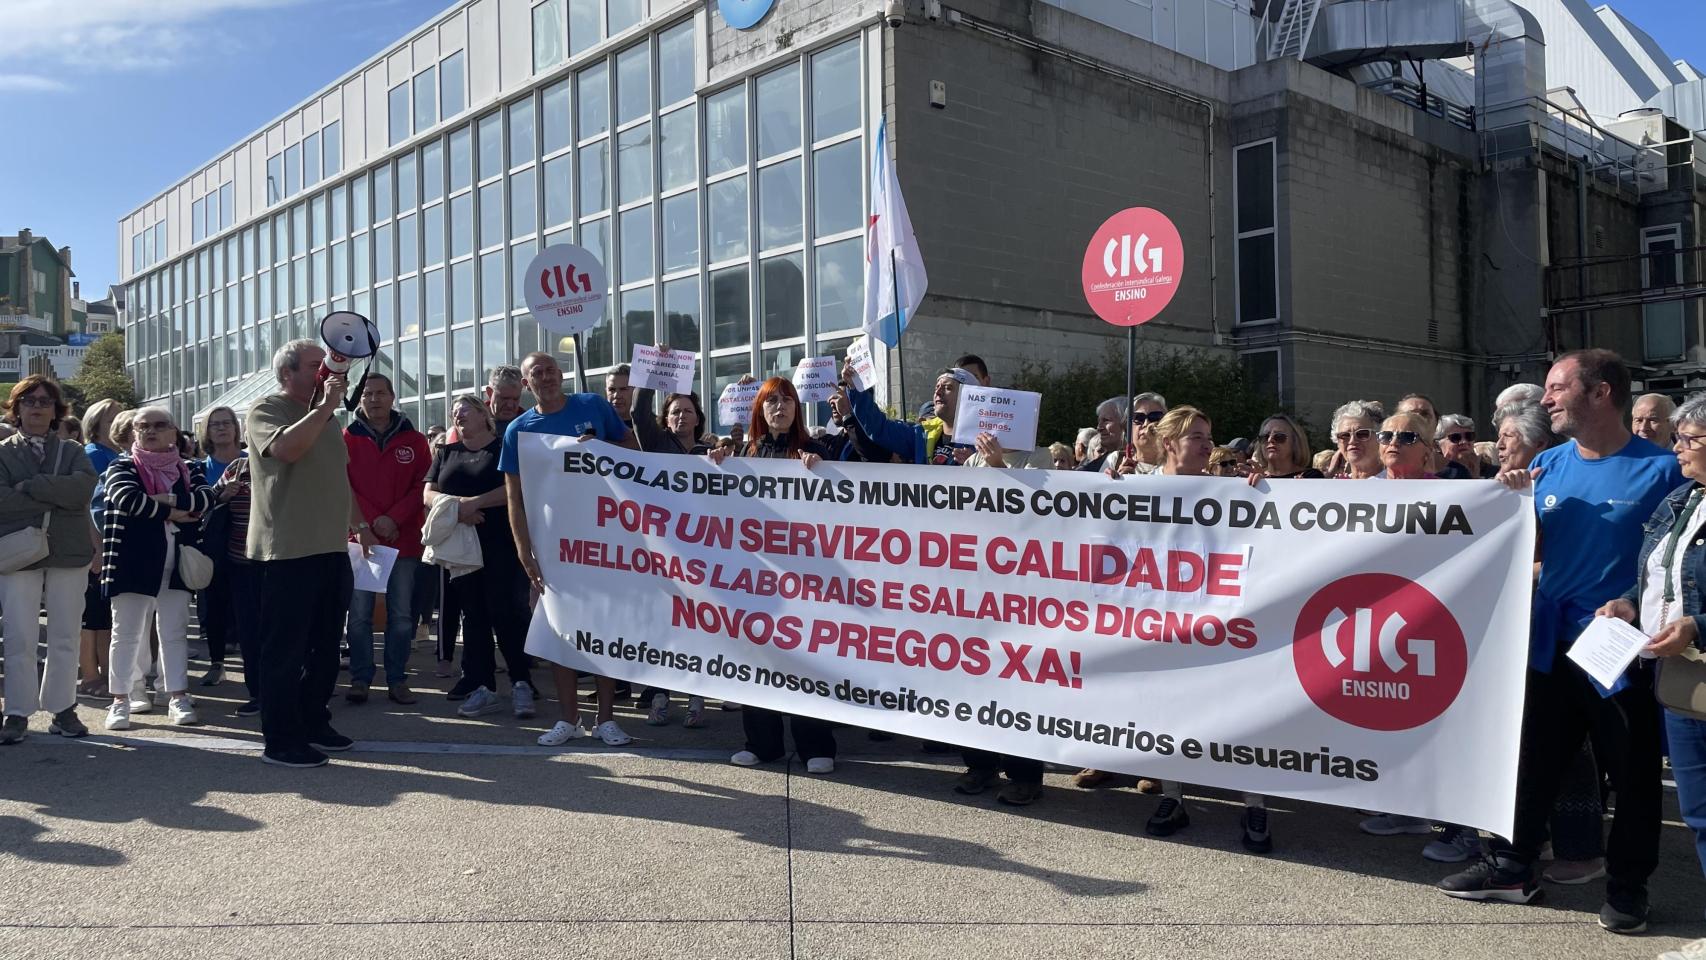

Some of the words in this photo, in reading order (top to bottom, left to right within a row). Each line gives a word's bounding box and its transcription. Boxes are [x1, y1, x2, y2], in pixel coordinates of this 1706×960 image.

[1103, 233, 1163, 278] CIG
[540, 263, 592, 299] CIG
[1115, 287, 1147, 301] ENSINO
[556, 304, 584, 317] ENSINO
[637, 358, 690, 371] PRECARIEDADE
[646, 368, 679, 379] SALARIAL
[967, 394, 986, 403] NAS
[990, 396, 1011, 406] EDM
[978, 408, 1014, 419] Salarios
[978, 420, 1012, 431] Dignos.
[563, 450, 689, 493] ESCOLAS
[692, 471, 855, 504] DEPORTIVAS
[859, 480, 1026, 515] MUNICIPAIS
[1030, 489, 1222, 527] CONCELLO
[1228, 499, 1282, 530] DA
[1289, 500, 1474, 536] CORUÑA
[597, 495, 672, 537] POR
[675, 512, 734, 550] UN
[739, 518, 912, 565] SERVIZO
[919, 530, 979, 572] DE
[985, 536, 1242, 597] CALIDADE
[559, 538, 707, 586] MELLORAS
[710, 564, 877, 608] LABORAIS
[882, 581, 904, 611] E
[908, 583, 1089, 632] SALARIOS
[1094, 603, 1258, 650] DIGNOS
[671, 595, 804, 650] NOVOS
[807, 619, 991, 676] PREGOS
[998, 640, 1083, 690] XA!
[1320, 606, 1436, 677] CIG
[1341, 678, 1410, 700] ENSINO
[575, 629, 605, 656] Na
[608, 637, 702, 674] defensa
[706, 654, 751, 683] dos
[754, 665, 830, 698] nosos
[834, 678, 950, 718] dereitos
[954, 701, 973, 722] e
[977, 700, 1032, 732] dos
[1036, 714, 1175, 757] usuarios
[1180, 737, 1204, 760] e
[1209, 741, 1379, 782] usuarias
